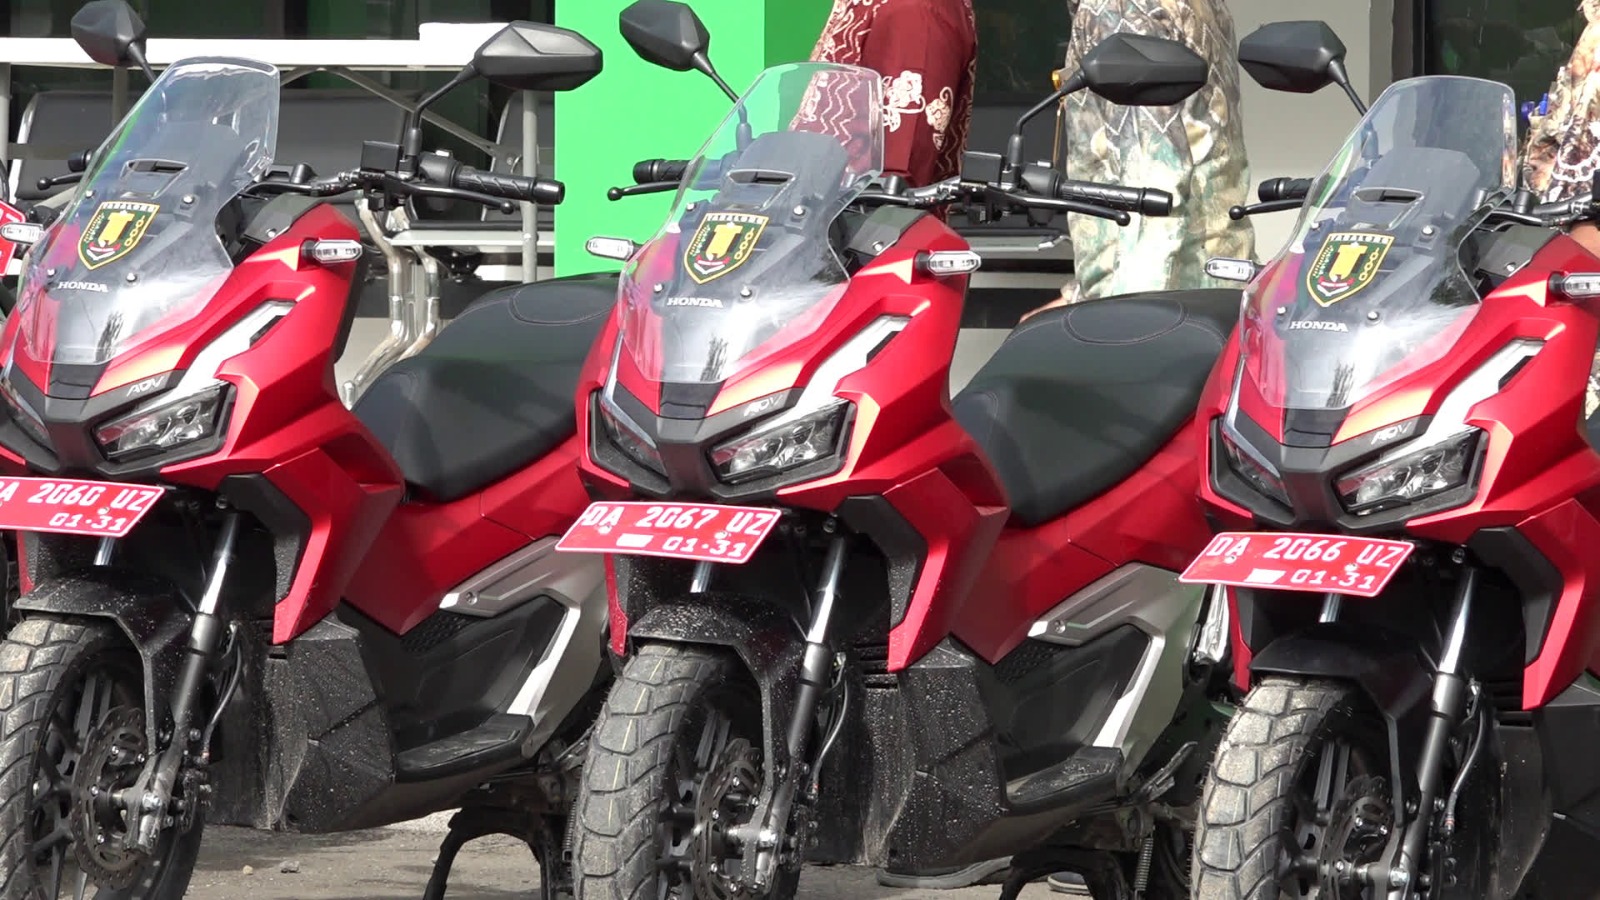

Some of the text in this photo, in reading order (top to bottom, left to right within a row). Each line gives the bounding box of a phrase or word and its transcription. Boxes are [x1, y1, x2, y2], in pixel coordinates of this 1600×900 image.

[58, 281, 109, 292] HONDA
[666, 297, 724, 309] HONDA
[1289, 320, 1349, 332] HONDA
[126, 375, 165, 397] ADV
[0, 481, 156, 511] A 2060 UZ
[580, 505, 774, 535] DA 2067 UZ
[1206, 536, 1404, 568] DA 2066 UZ
